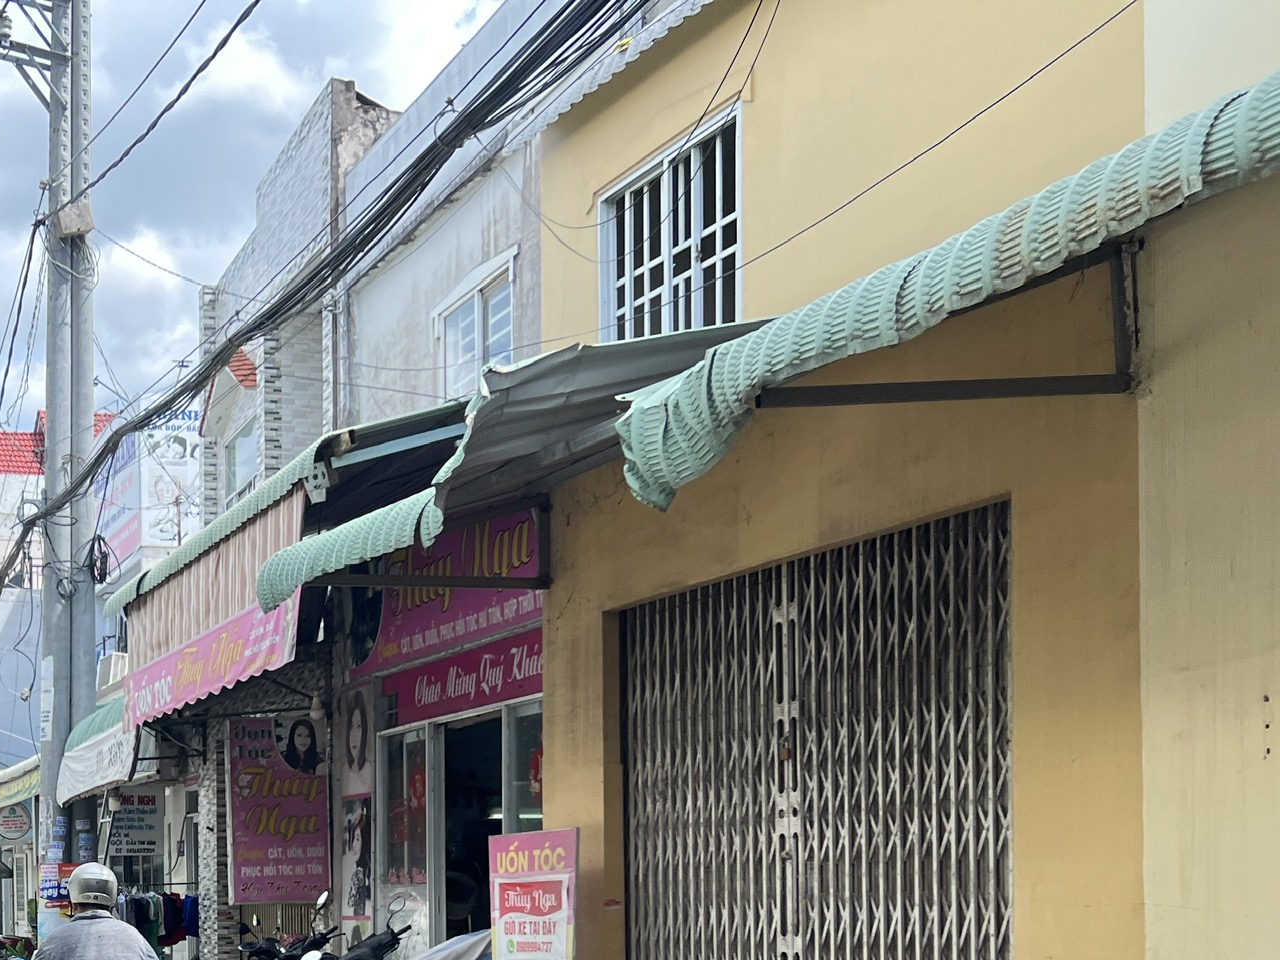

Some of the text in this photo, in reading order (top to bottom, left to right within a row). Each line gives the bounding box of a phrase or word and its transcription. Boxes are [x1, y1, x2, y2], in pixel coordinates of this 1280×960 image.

[154, 670, 172, 709] TÓC
[415, 644, 543, 707] Chào Mừng Quý Khác
[137, 795, 156, 806] NGHI
[245, 803, 320, 842] Nga
[497, 841, 565, 874] UỐN TÓC
[504, 886, 557, 913] Thúy Nga
[518, 921, 527, 936] XE
[529, 921, 540, 939] TẠI
[542, 918, 558, 936] ĐÂY
